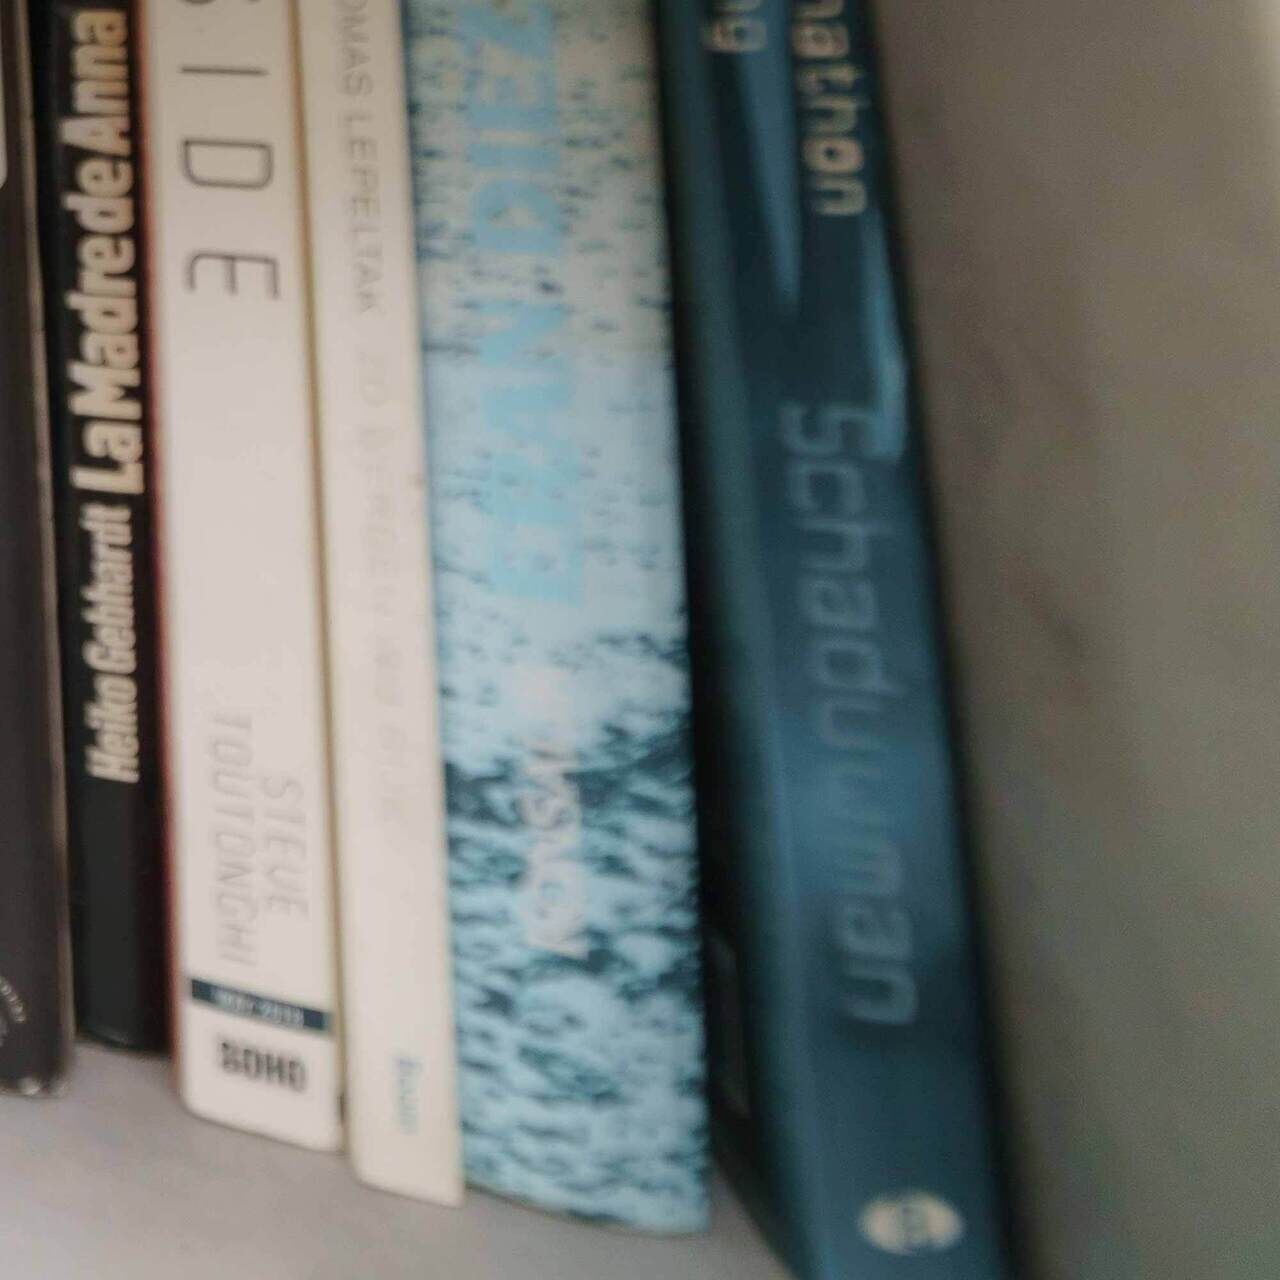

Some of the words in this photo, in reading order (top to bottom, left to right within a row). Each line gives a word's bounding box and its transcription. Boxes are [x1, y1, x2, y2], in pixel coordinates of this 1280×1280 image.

[58, 9, 133, 155] Anna
[63, 158, 135, 232] de
[65, 232, 144, 420] Madre
[68, 420, 146, 496] La
[76, 505, 138, 676] Gebhardt
[82, 675, 141, 785] Heiko
[216, 1035, 310, 1094] SOHO
